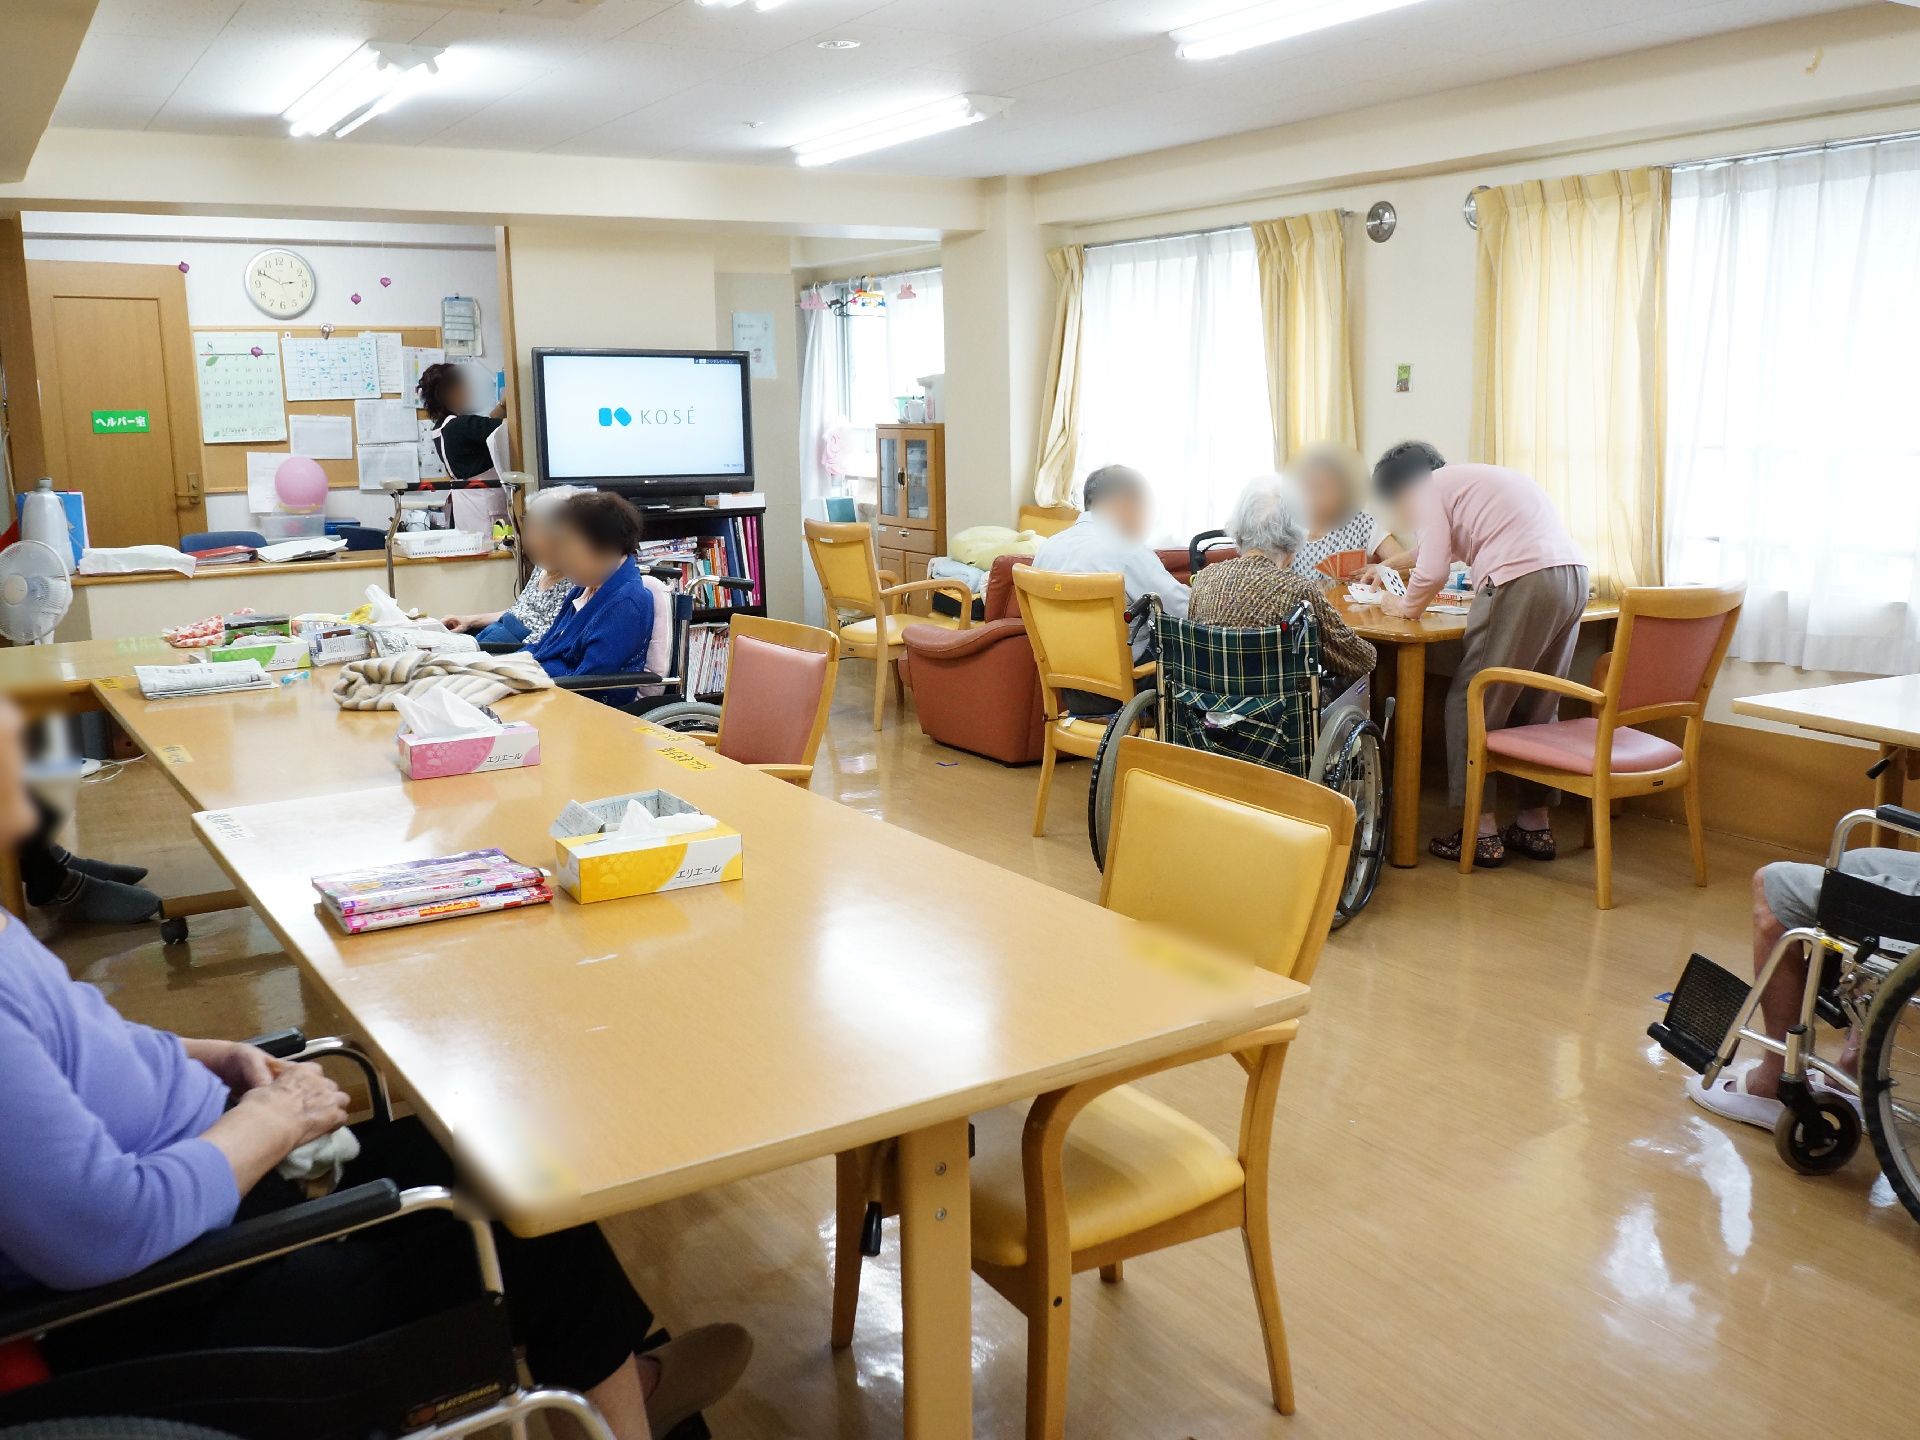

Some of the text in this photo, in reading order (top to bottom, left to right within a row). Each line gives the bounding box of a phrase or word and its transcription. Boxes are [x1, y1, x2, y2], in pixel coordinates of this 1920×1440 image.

[275, 257, 284, 266] 12
[297, 268, 303, 277] 2
[95, 415, 147, 427] ヘルパー室
[640, 405, 696, 425] KOSÉ
[486, 752, 523, 764] エリエール
[675, 864, 722, 880] エリエール
